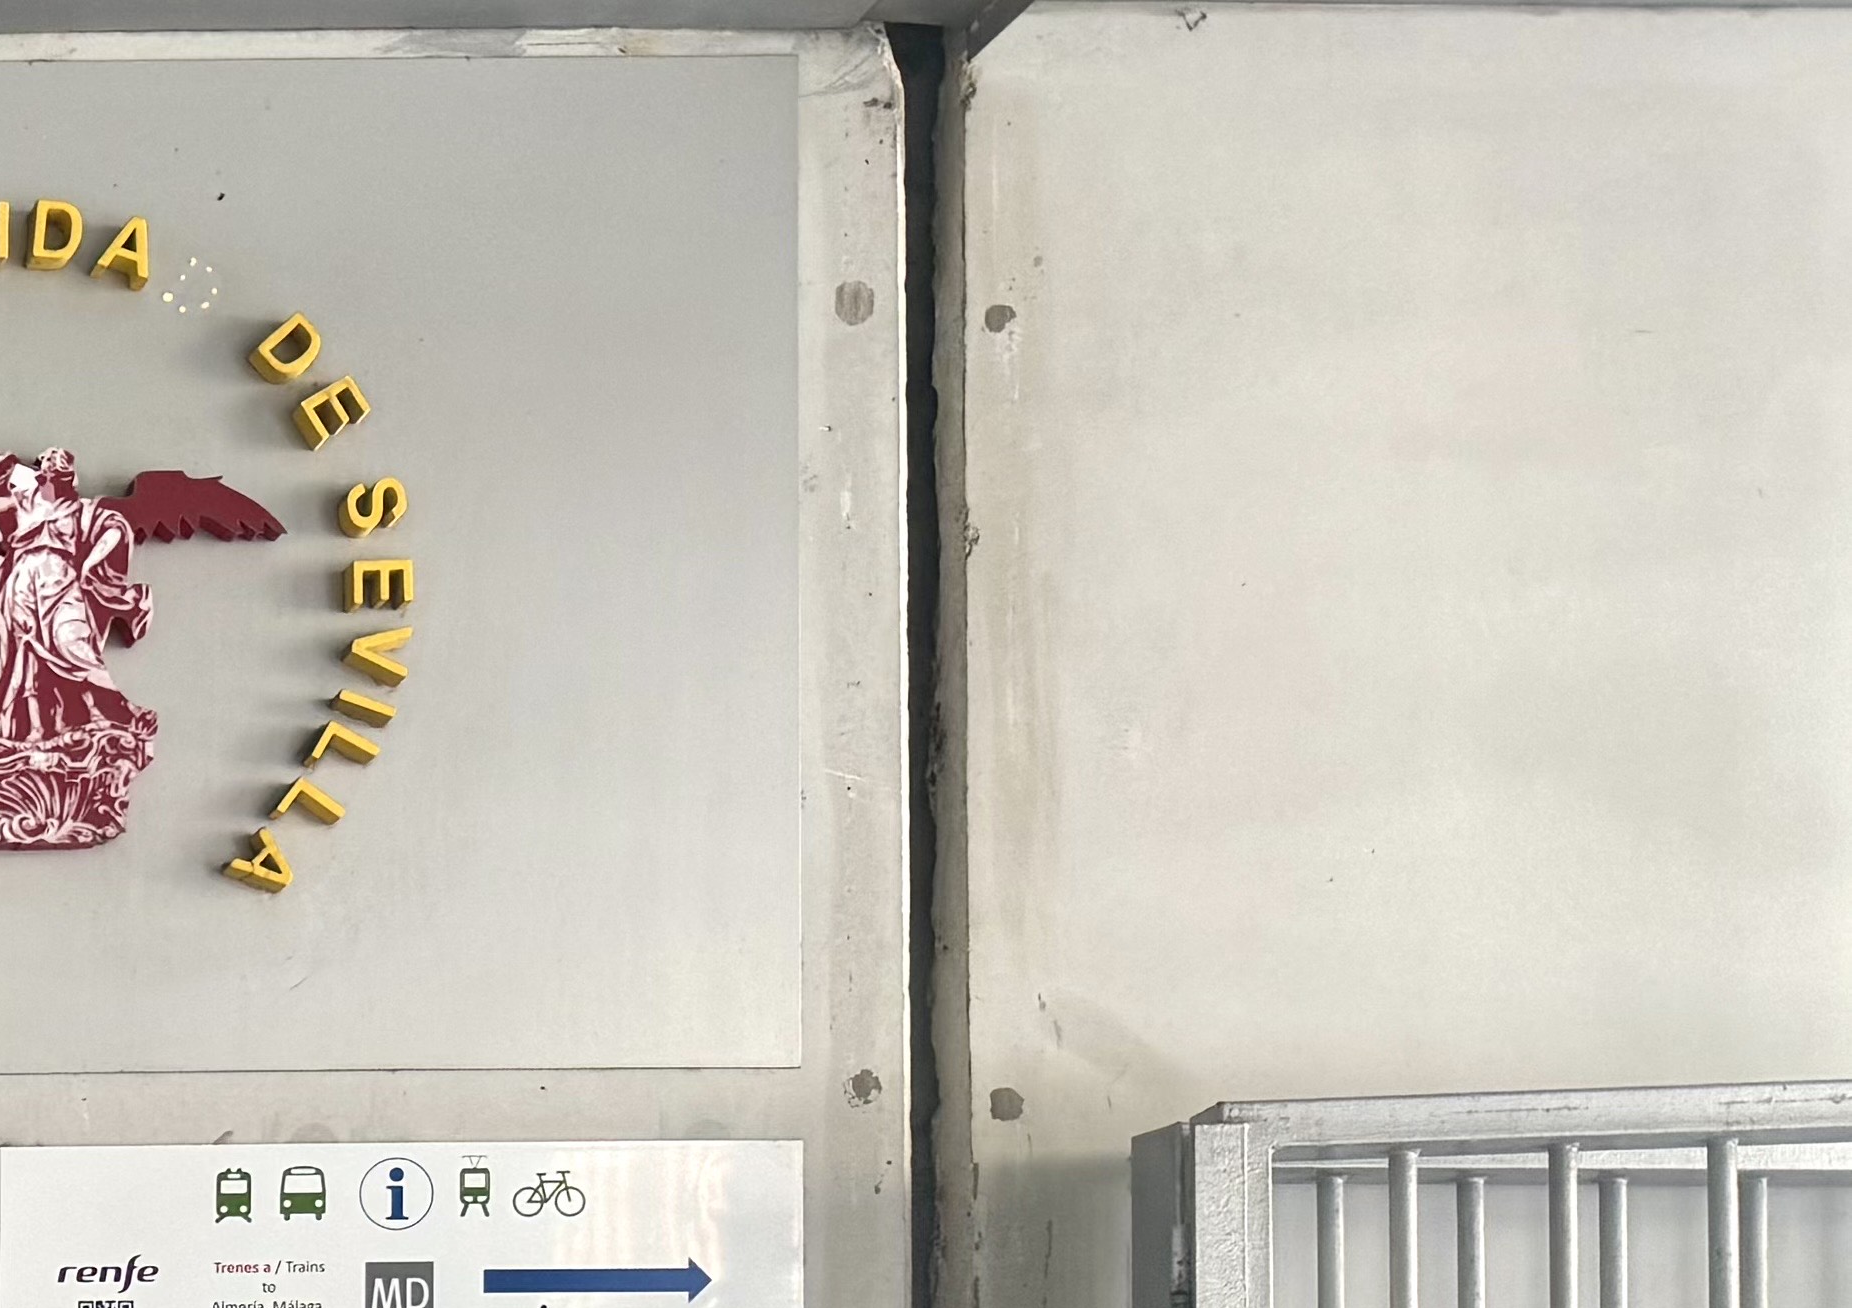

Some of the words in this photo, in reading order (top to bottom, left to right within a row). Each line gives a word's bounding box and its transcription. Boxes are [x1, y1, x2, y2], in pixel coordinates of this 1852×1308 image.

[248, 312, 372, 451] DE
[222, 476, 414, 893] SEVILLA
[57, 1254, 159, 1294] renfe
[213, 1261, 260, 1274] Trenes
[263, 1263, 271, 1273] a
[274, 1259, 282, 1275] /
[285, 1260, 326, 1273] Trains
[261, 1282, 277, 1294] to
